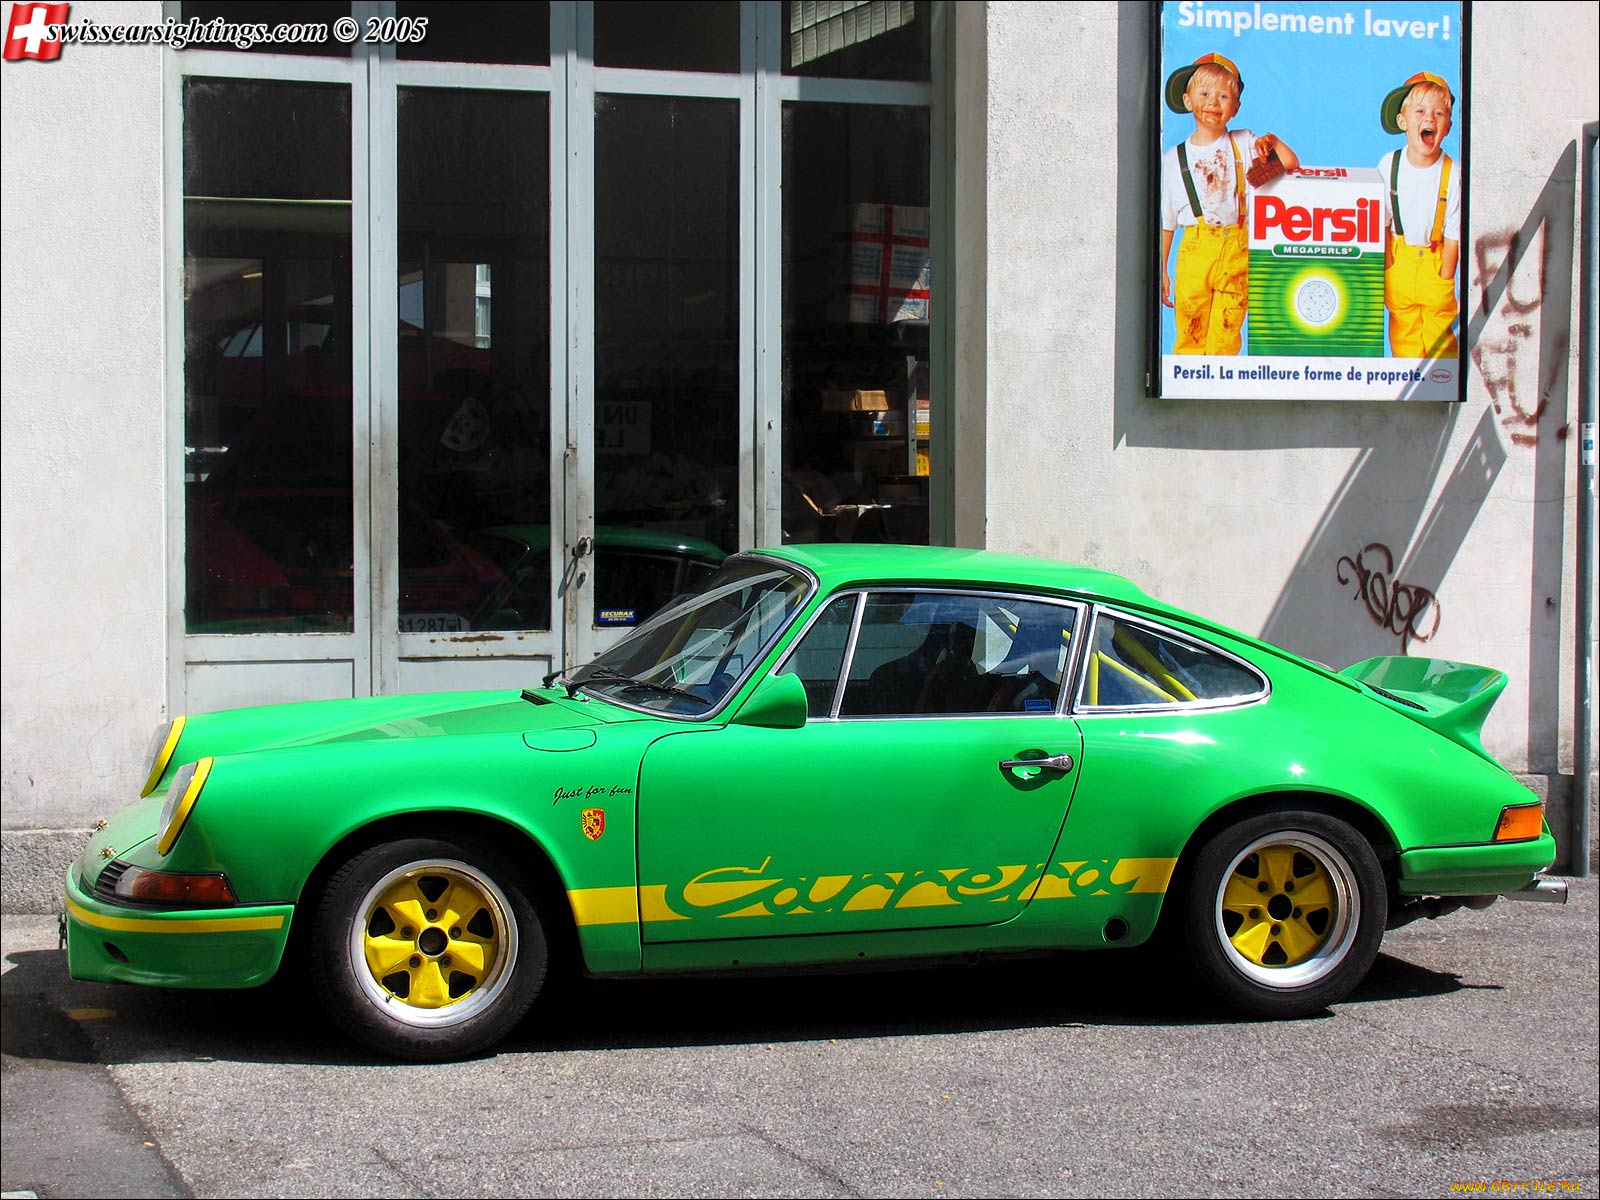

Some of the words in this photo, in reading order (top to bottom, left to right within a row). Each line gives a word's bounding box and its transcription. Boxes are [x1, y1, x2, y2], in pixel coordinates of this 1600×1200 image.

[1178, 1, 1355, 37] Simplement
[1365, 9, 1451, 41] laver!
[1254, 195, 1381, 243] Persil
[1173, 365, 1215, 380] Persil.
[1219, 366, 1234, 380] La
[1238, 366, 1300, 380] meilleure
[1304, 366, 1343, 381] forme
[1346, 366, 1362, 381] de
[1366, 368, 1426, 385] propreté.
[552, 786, 583, 806] Just
[585, 784, 607, 799] for
[609, 784, 632, 797] fun
[664, 856, 1146, 920] Carrera
